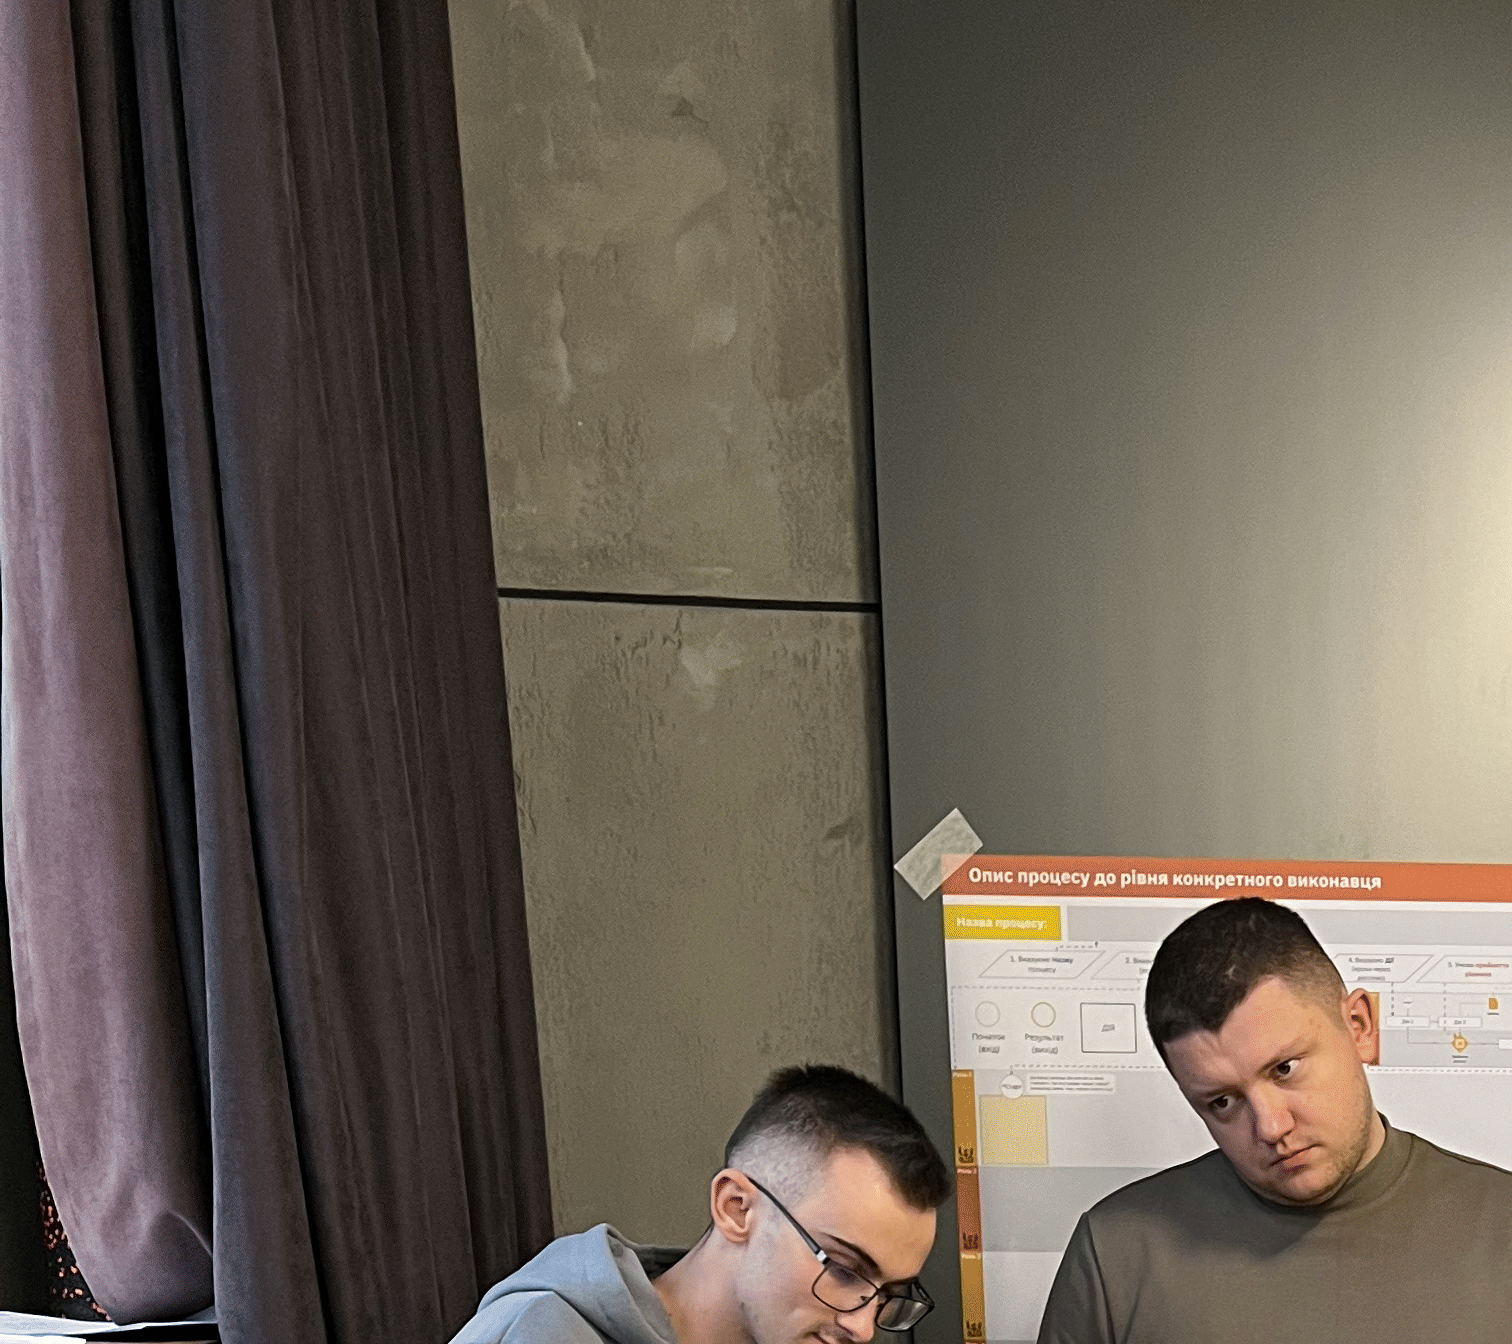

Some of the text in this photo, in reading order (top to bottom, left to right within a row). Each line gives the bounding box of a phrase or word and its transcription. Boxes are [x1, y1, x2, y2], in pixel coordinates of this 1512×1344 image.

[968, 867, 1382, 890] Опис процесу до рівня конкретного виконавця
[956, 917, 993, 928] Назва
